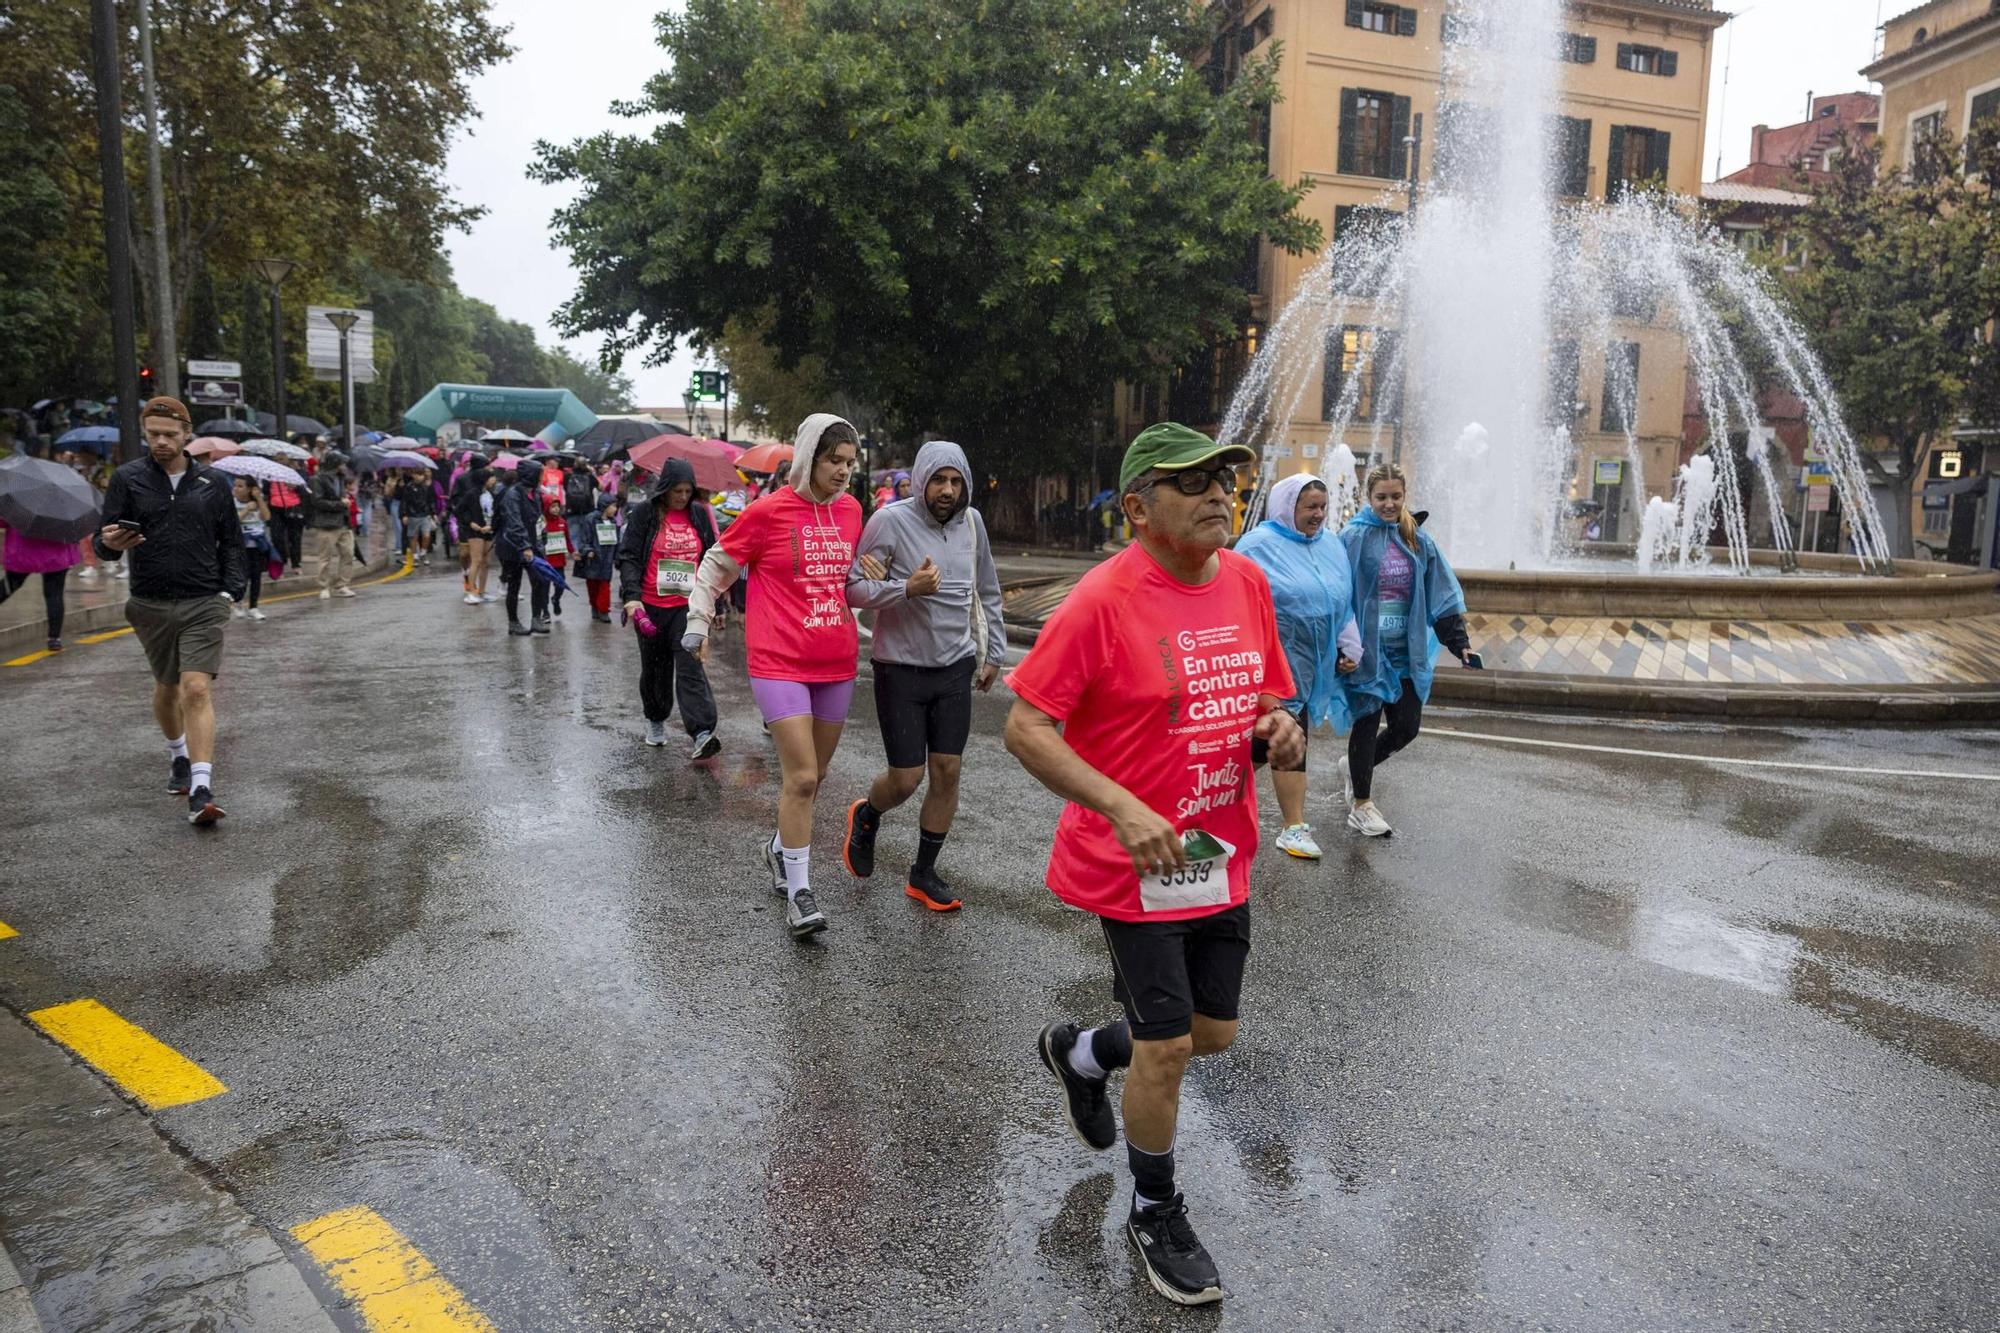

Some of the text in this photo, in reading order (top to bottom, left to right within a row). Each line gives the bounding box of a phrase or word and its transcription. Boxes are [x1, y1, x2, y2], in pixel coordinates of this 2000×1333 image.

[703, 374, 716, 392] P
[470, 393, 504, 404] Esports
[803, 539, 819, 551] En
[804, 551, 843, 561] contra
[666, 572, 689, 583] 5024
[807, 597, 841, 616] Junts
[803, 615, 842, 629] som un
[1182, 650, 1263, 676] En marxa
[1158, 636, 1181, 724] MALLORCA
[1187, 665, 1265, 695] contra el
[1188, 692, 1260, 721] cànce
[1226, 732, 1241, 745] OK
[1187, 757, 1240, 797] Junts
[1176, 787, 1237, 820] som un
